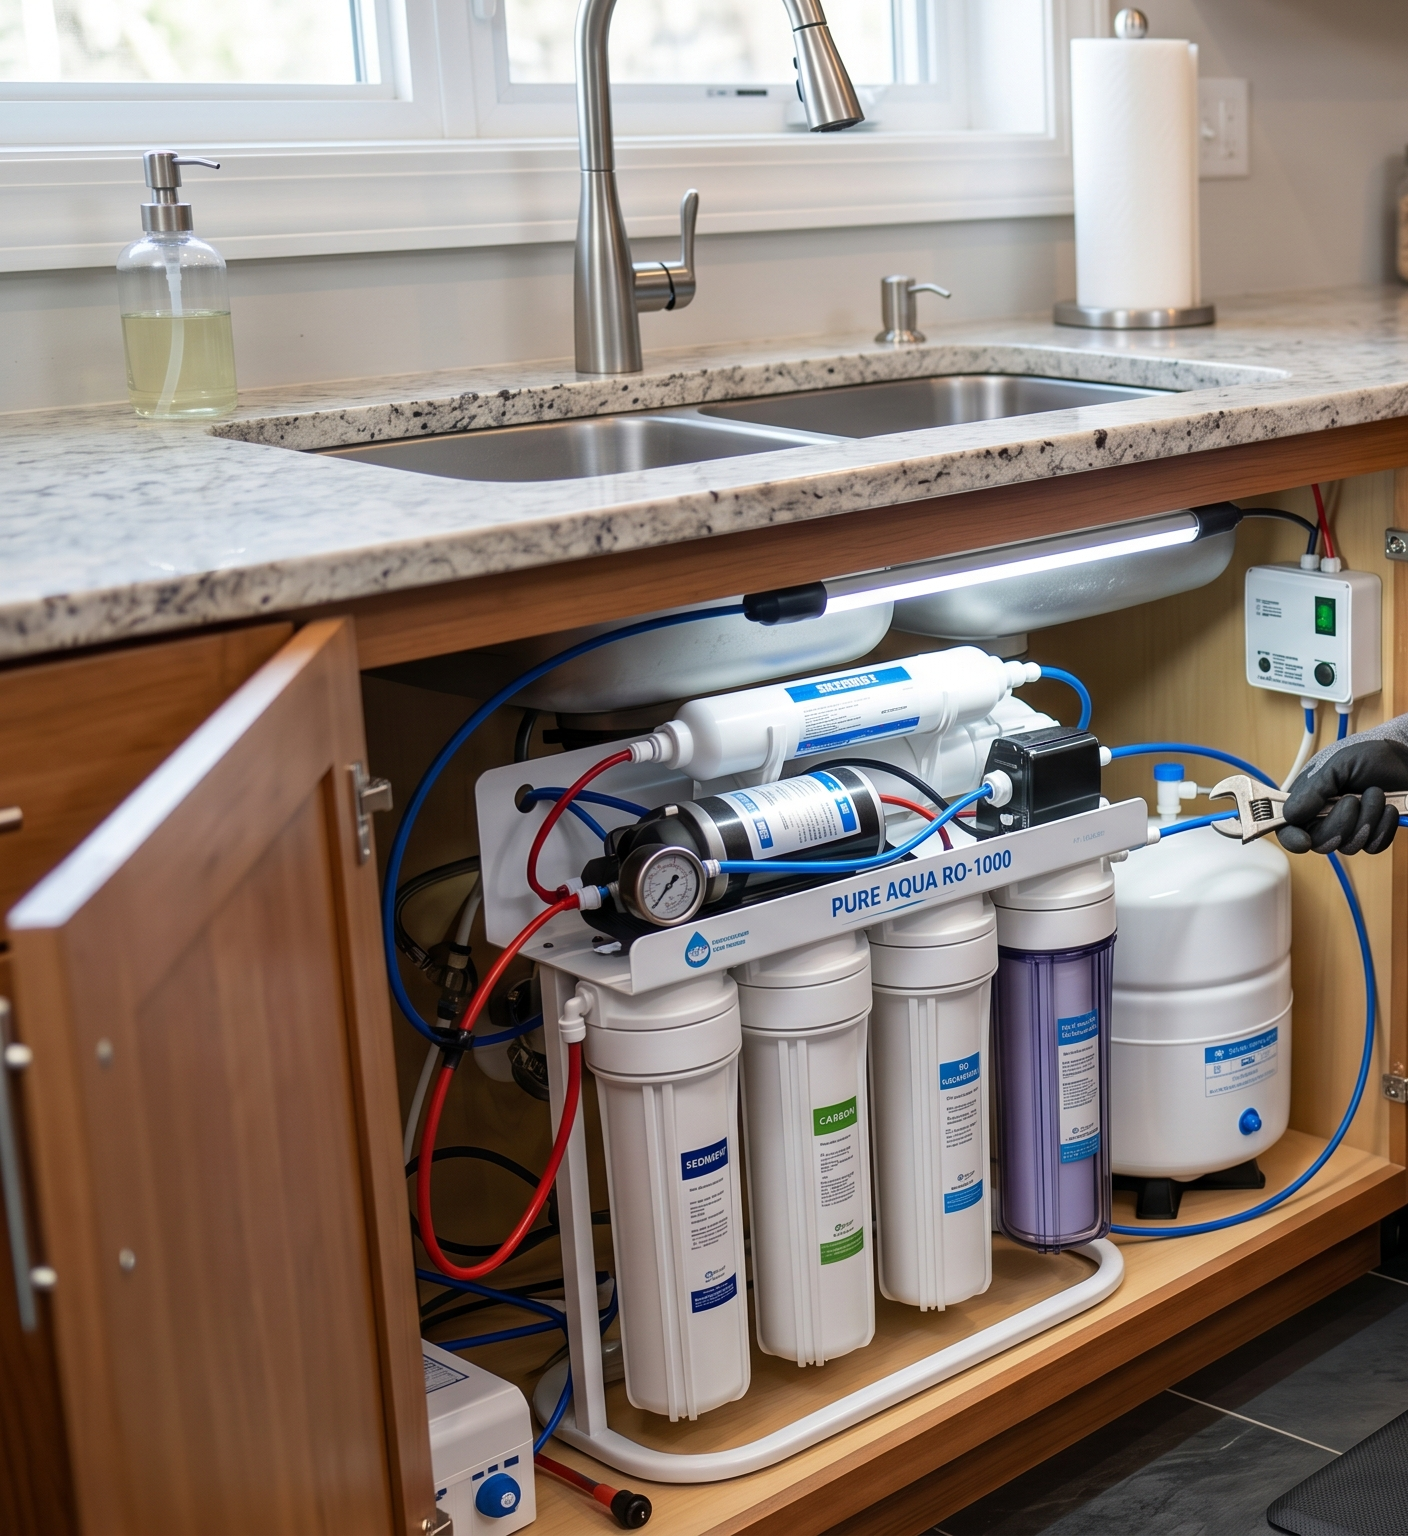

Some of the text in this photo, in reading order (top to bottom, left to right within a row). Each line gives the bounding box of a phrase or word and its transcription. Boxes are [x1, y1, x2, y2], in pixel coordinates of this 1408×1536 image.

[832, 849, 1011, 917] PURE AQUA RO-1000
[819, 1106, 855, 1125] CARBON
